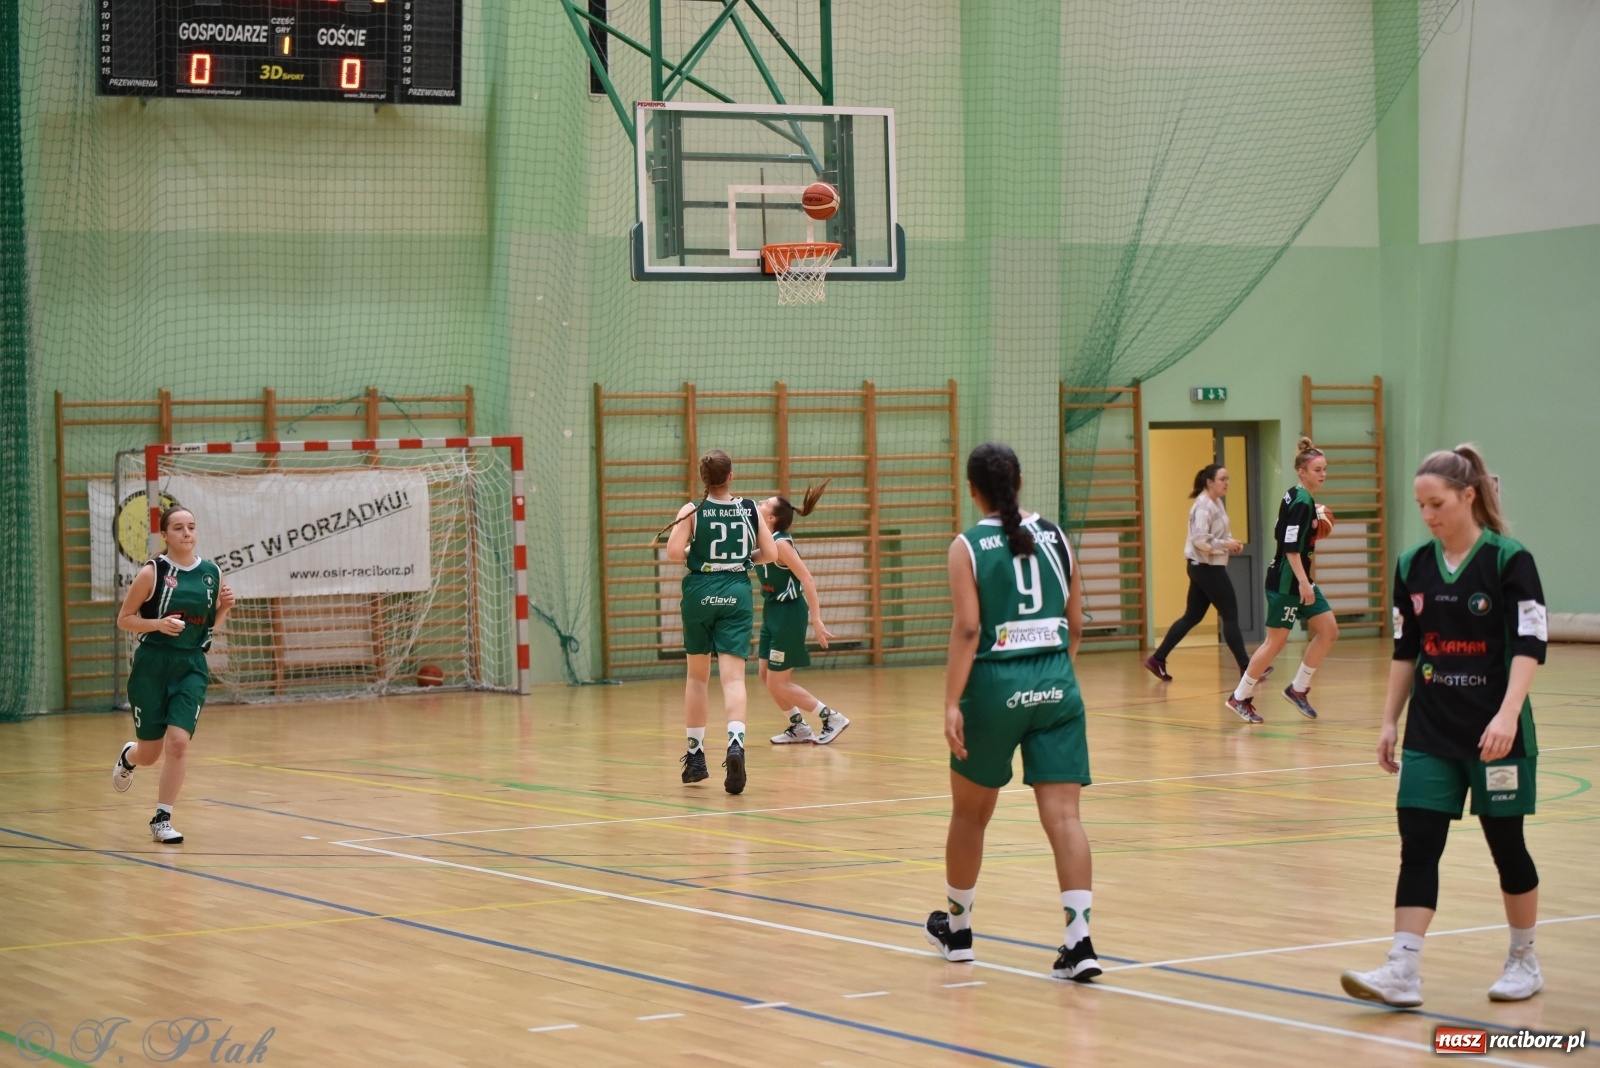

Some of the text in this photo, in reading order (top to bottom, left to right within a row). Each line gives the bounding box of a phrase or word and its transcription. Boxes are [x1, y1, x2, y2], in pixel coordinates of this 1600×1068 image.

[102, 0, 109, 8] 9
[404, 2, 411, 10] 8
[101, 12, 111, 20] 10
[404, 13, 411, 21] 9
[271, 17, 296, 26] CZĘŚĆ
[101, 23, 110, 31] 11
[402, 24, 413, 32] 10
[179, 22, 269, 42] GOSPODARZE
[317, 24, 367, 46] GOŚCIE
[101, 34, 111, 42] 12
[283, 36, 290, 55] 1
[402, 45, 413, 53] 12
[402, 56, 412, 64] 13
[190, 54, 211, 84] 0
[260, 65, 284, 80] 3D
[341, 58, 361, 88] 0
[109, 79, 158, 88] PRZEWINIENIA
[402, 77, 411, 85] 15
[408, 88, 456, 97] PRZEWINIENIA
[703, 508, 752, 518] RKK RACIBORZ
[212, 489, 409, 573] EST W PORZĄDKU!
[710, 522, 748, 559] 23
[979, 534, 1004, 550] RKK
[290, 564, 415, 579] www.osir-raciborz.pl
[1012, 554, 1043, 615] 9
[709, 595, 738, 604] Clavis
[1020, 687, 1064, 704] Clavis
[134, 706, 141, 728] 5
